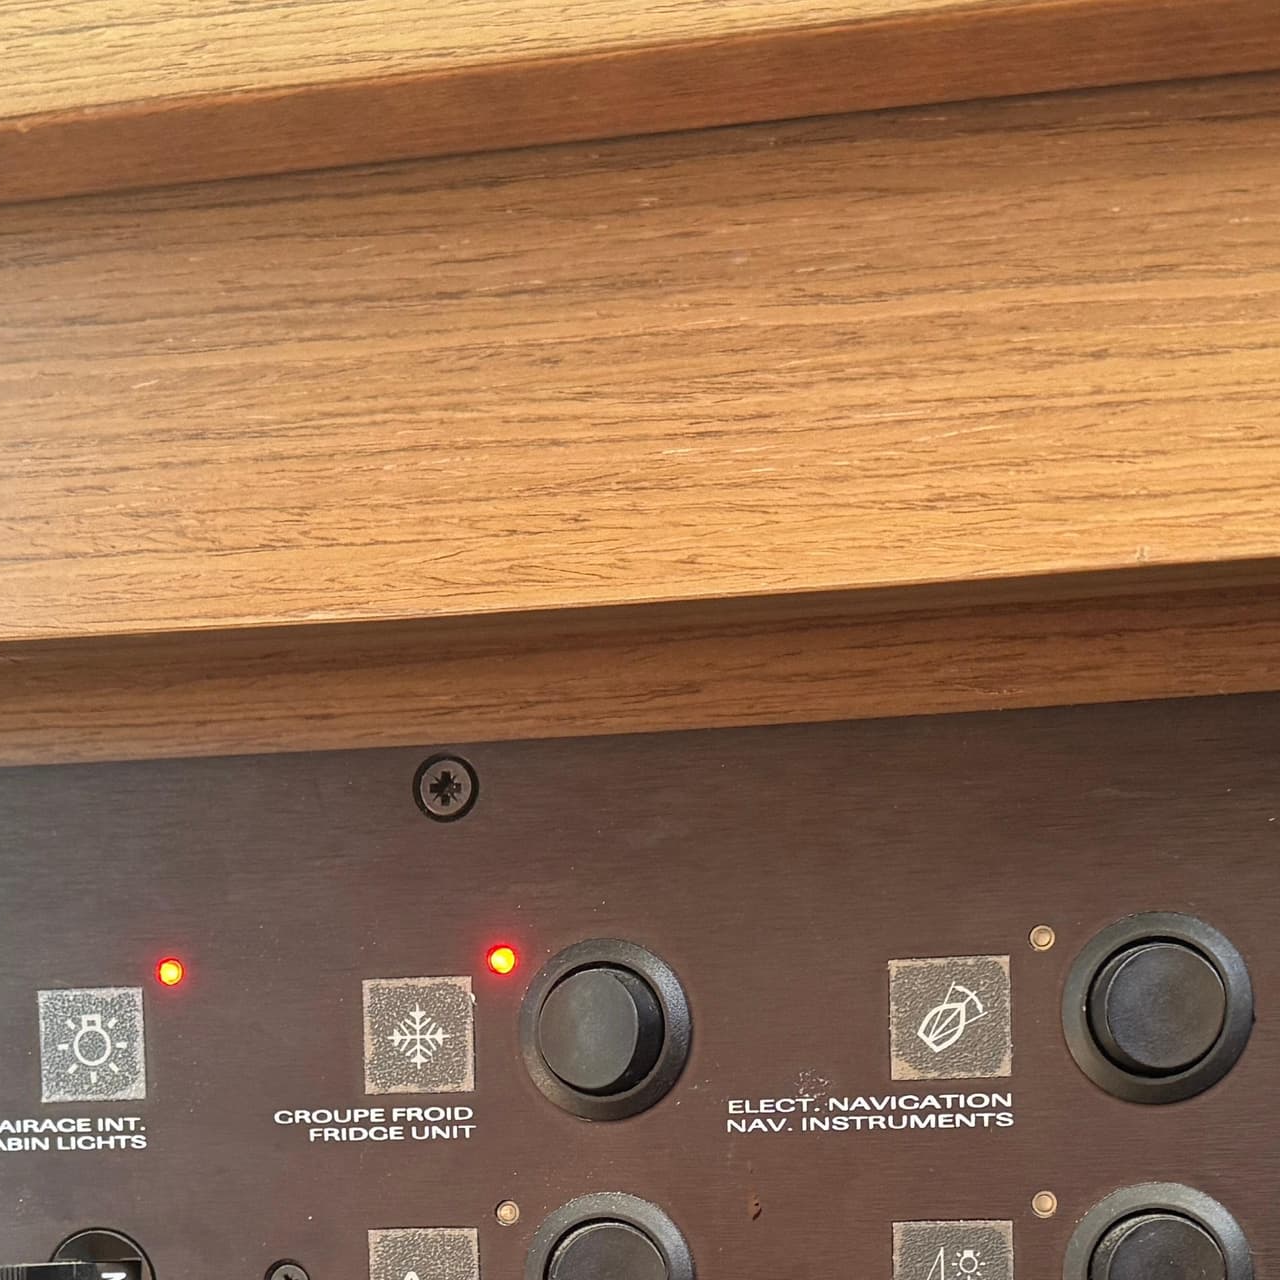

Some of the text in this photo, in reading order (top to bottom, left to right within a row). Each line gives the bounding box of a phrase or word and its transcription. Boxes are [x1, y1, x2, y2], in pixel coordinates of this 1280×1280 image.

[727, 1092, 1012, 1114] ELECT. NAVIGATION
[97, 1117, 146, 1132] INT.
[273, 1106, 474, 1125] GROUPE FROID
[726, 1111, 1014, 1133] NAV. INSTRUMENTS
[309, 1125, 477, 1142] FRIDGE UNIT
